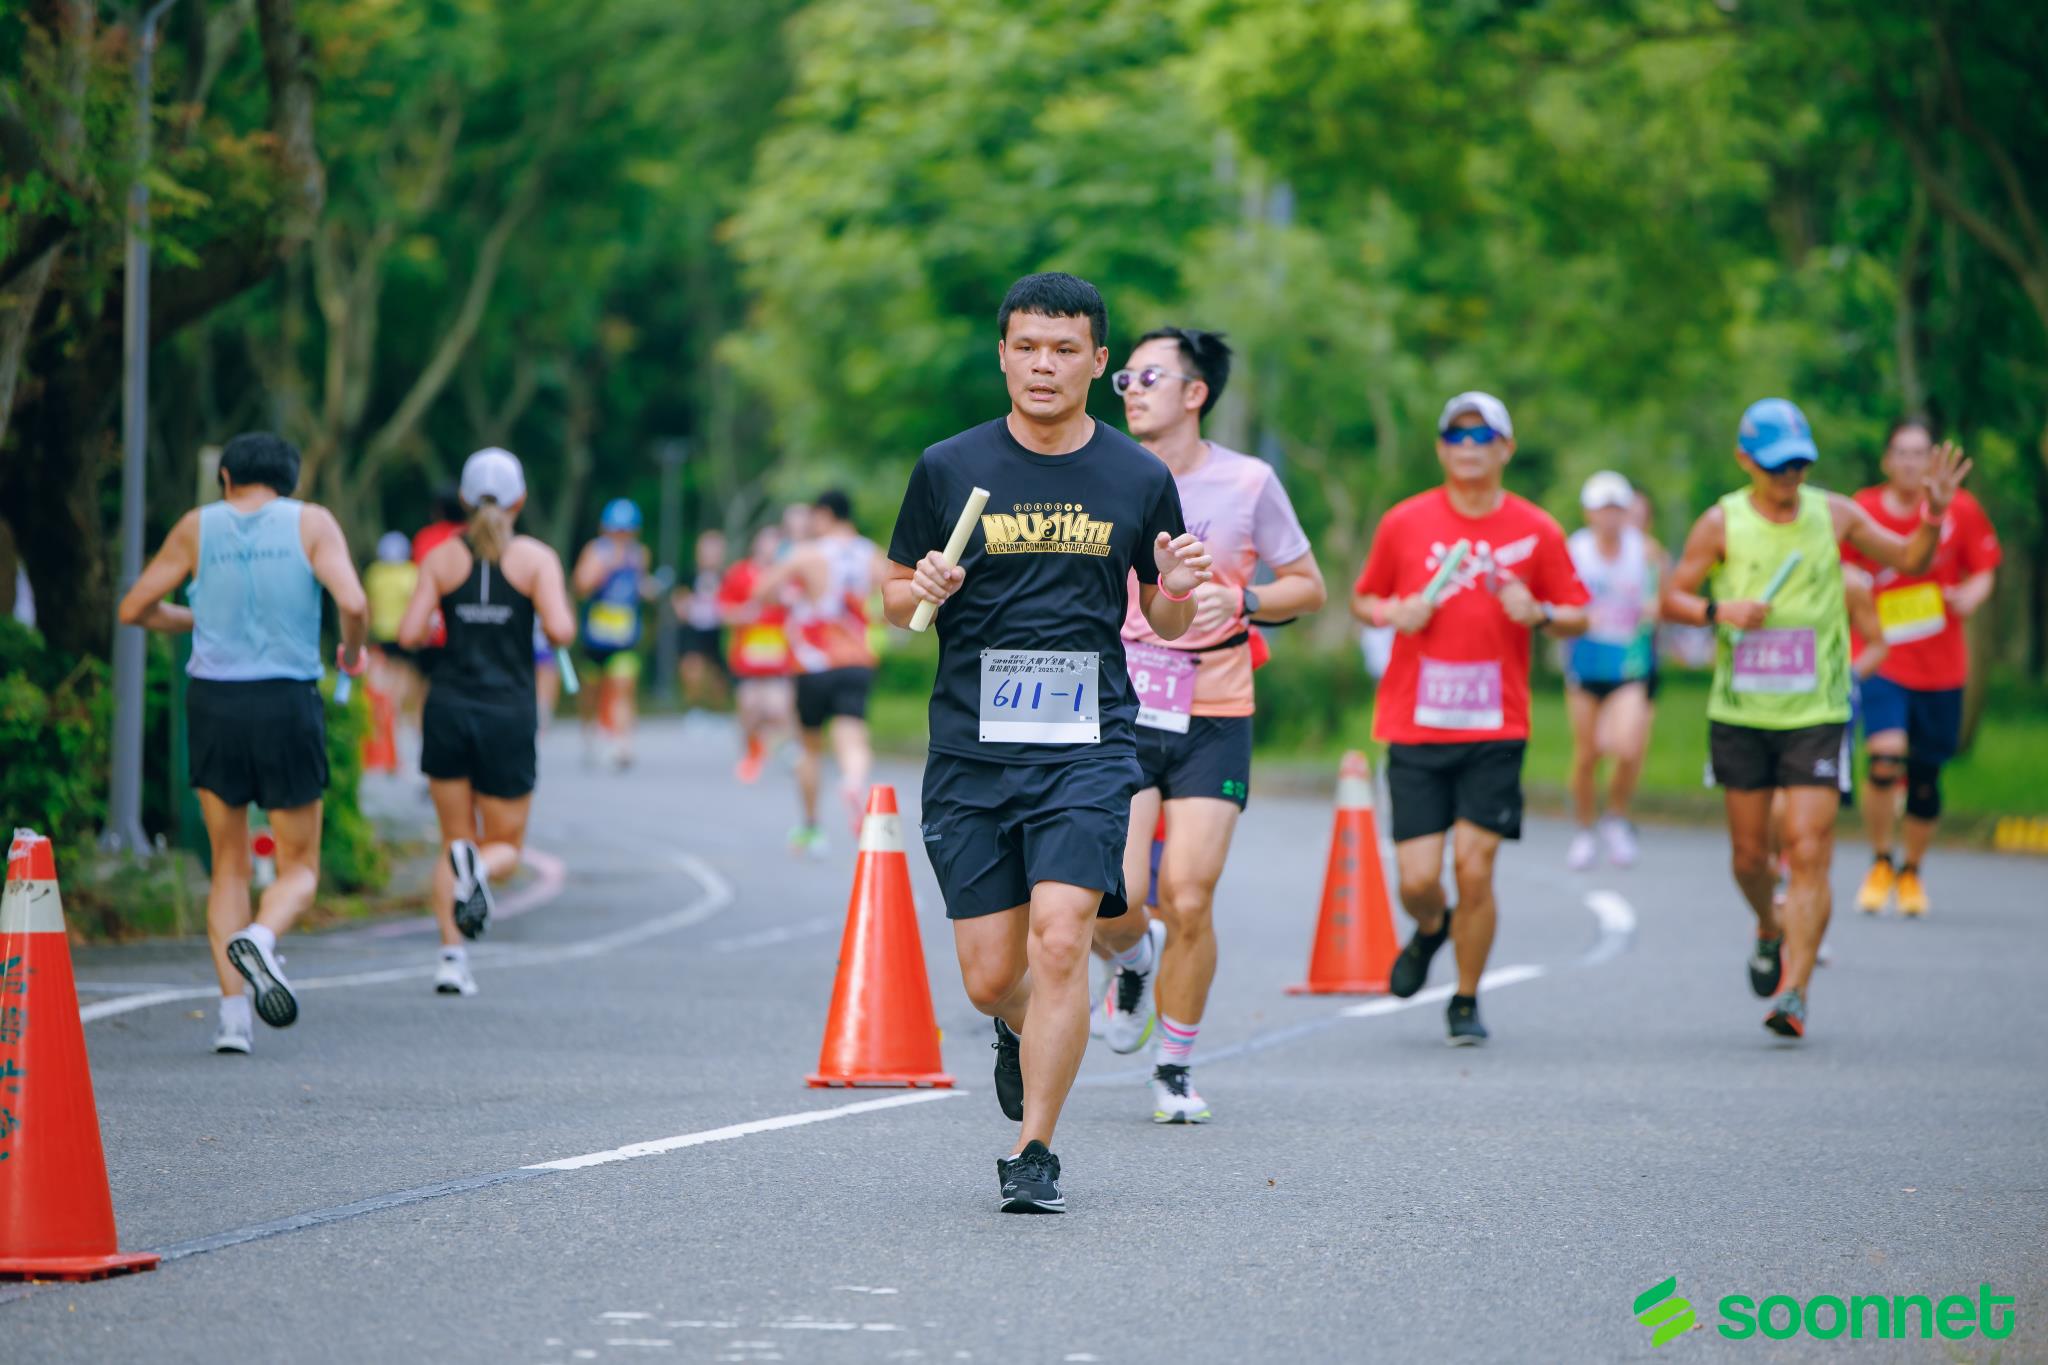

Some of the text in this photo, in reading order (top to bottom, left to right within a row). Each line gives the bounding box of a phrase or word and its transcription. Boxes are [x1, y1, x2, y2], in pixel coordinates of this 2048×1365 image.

[1014, 503, 1062, 512] CLASS
[981, 511, 1114, 544] NDU 114TH
[1006, 542, 1024, 552] ARMY
[1025, 542, 1057, 552] COMMAND
[1058, 543, 1063, 552] &
[1063, 543, 1082, 553] STAFF
[1082, 544, 1110, 556] COLLEGE
[993, 679, 1084, 712] 611-1
[1127, 669, 1177, 699] 8-1
